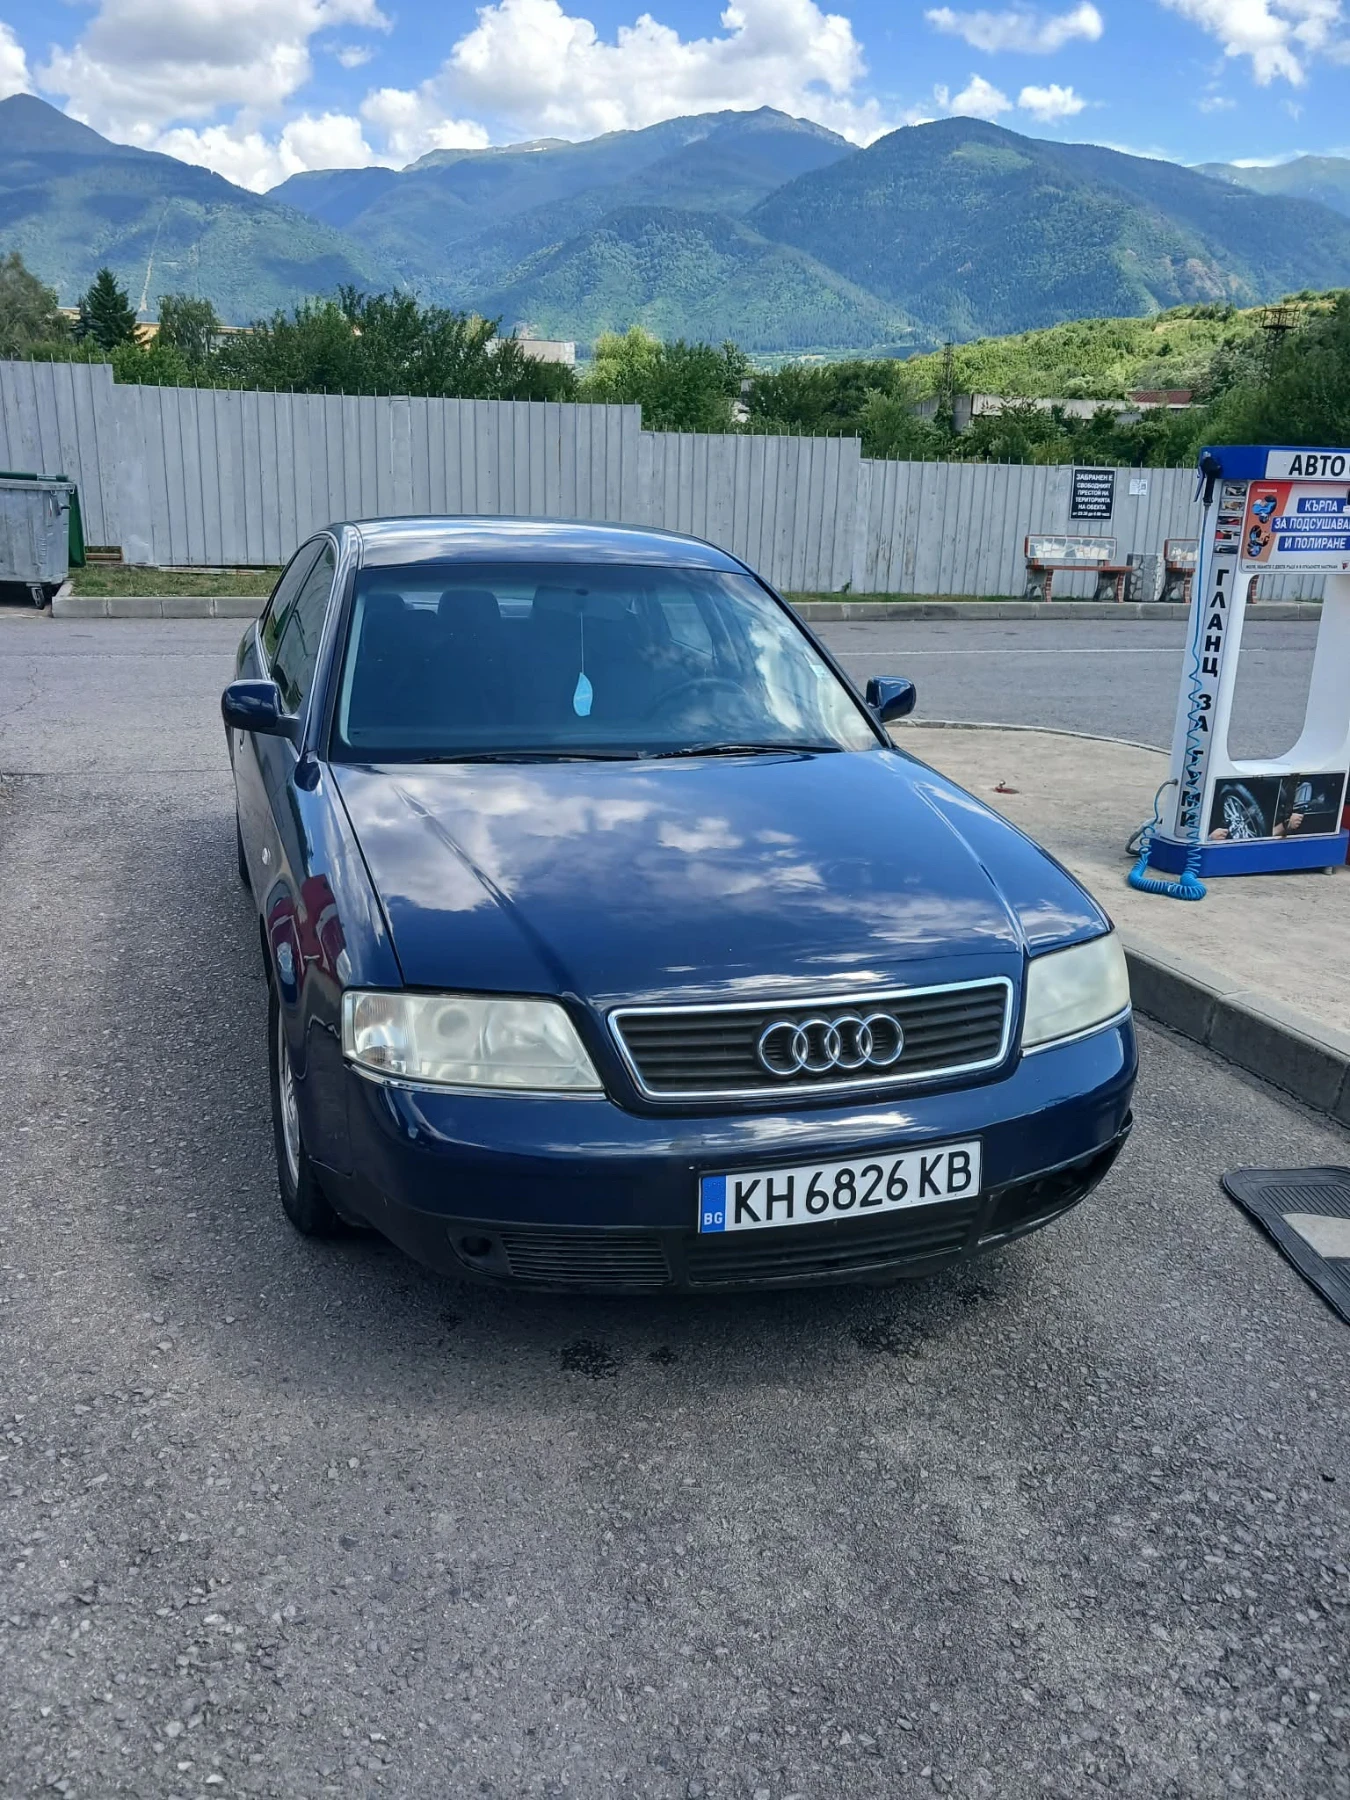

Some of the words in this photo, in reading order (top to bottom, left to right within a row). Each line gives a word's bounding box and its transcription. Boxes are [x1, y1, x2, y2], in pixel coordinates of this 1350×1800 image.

[1288, 454, 1346, 477] АВТО
[1109, 474, 1114, 482] Е
[1304, 499, 1338, 512] КЪРПА
[1274, 517, 1287, 529] ЗА
[1289, 517, 1350, 532] ПОДСУШАВА
[1284, 537, 1293, 549] И
[1294, 537, 1347, 549] ПОЛИРАНЕ
[1201, 569, 1230, 678] ГЛАНЦ
[703, 1211, 723, 1226] BG
